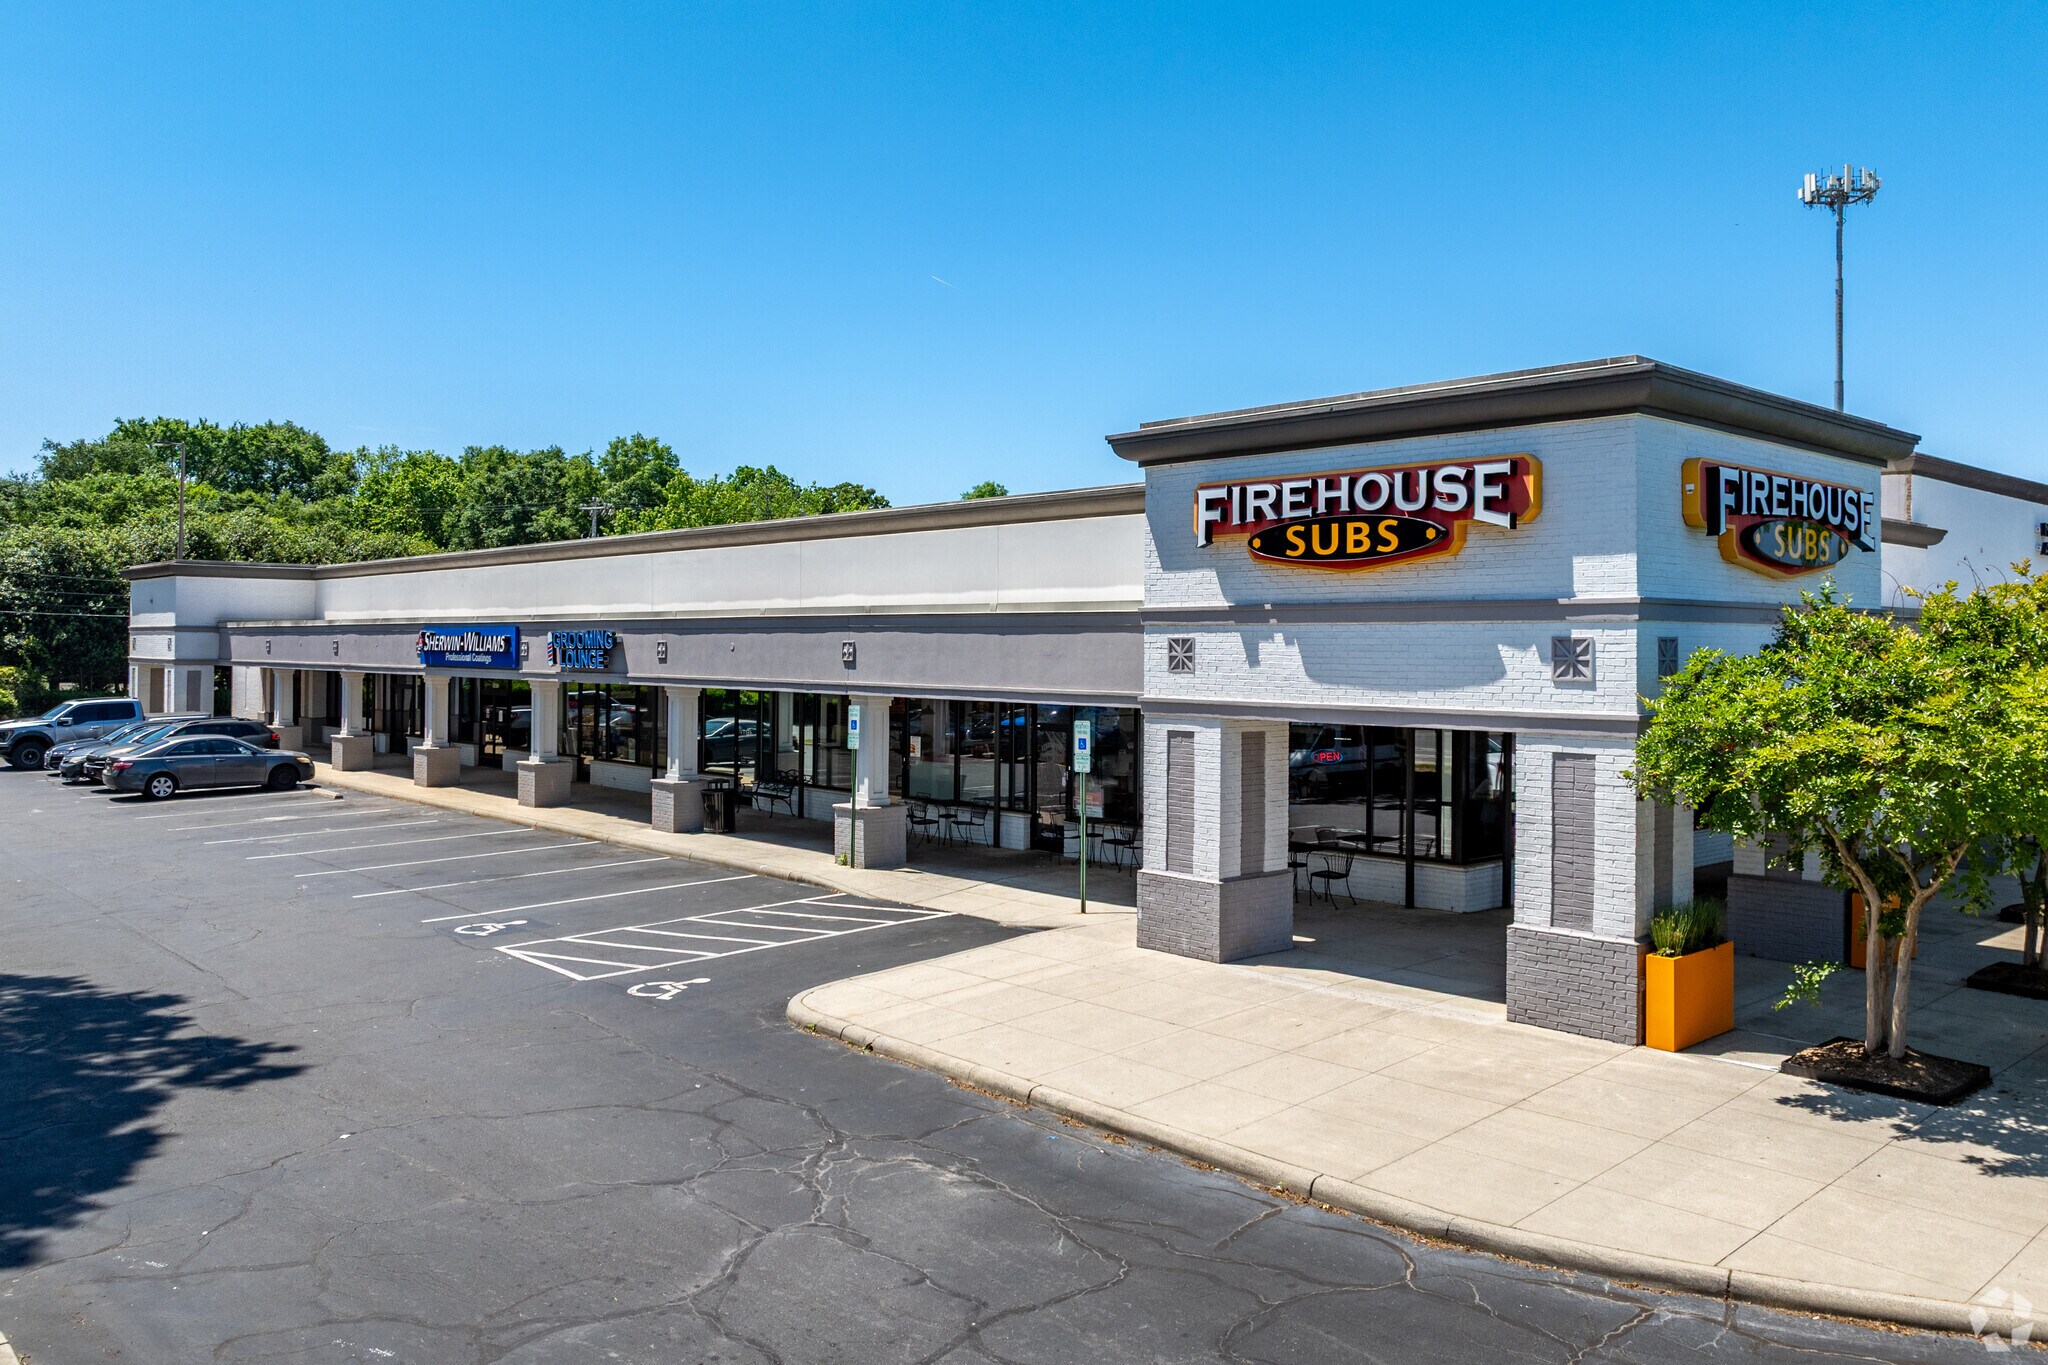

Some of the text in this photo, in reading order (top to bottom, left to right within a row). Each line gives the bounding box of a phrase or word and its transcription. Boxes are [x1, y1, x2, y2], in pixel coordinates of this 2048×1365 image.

[1196, 459, 1516, 548] FIREHOUSE
[1717, 466, 1875, 551] FIREHOUSE
[1286, 519, 1399, 557] SUBS
[1774, 524, 1830, 562] SUBS
[423, 631, 506, 652] SHERWIN-WILLIAMS
[553, 630, 613, 650] GROOMING
[445, 652, 492, 664] Professional Coatings
[559, 649, 605, 669] LOUNGE
[1312, 751, 1341, 763] OPEN
